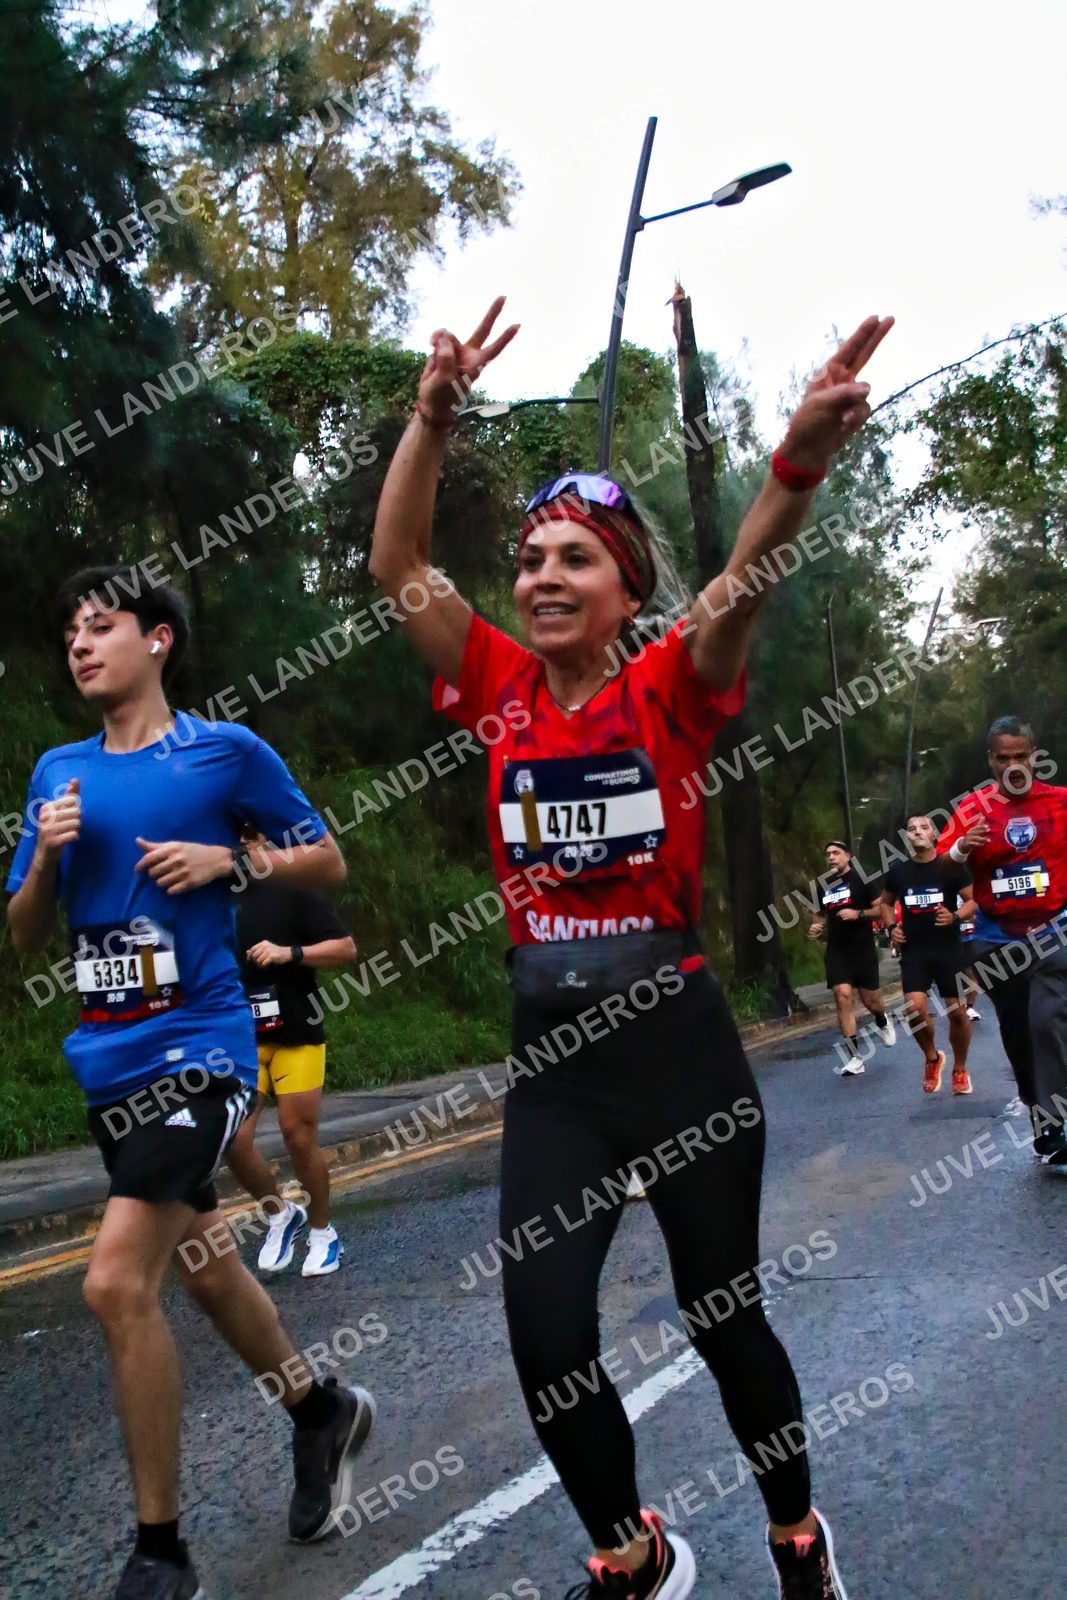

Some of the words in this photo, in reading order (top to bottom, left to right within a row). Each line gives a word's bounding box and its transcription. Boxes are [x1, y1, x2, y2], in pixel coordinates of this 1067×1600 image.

[547, 802, 607, 838] 4747
[627, 853, 654, 866] 10K
[1007, 876, 1032, 891] 5196
[93, 959, 139, 988] 5334
